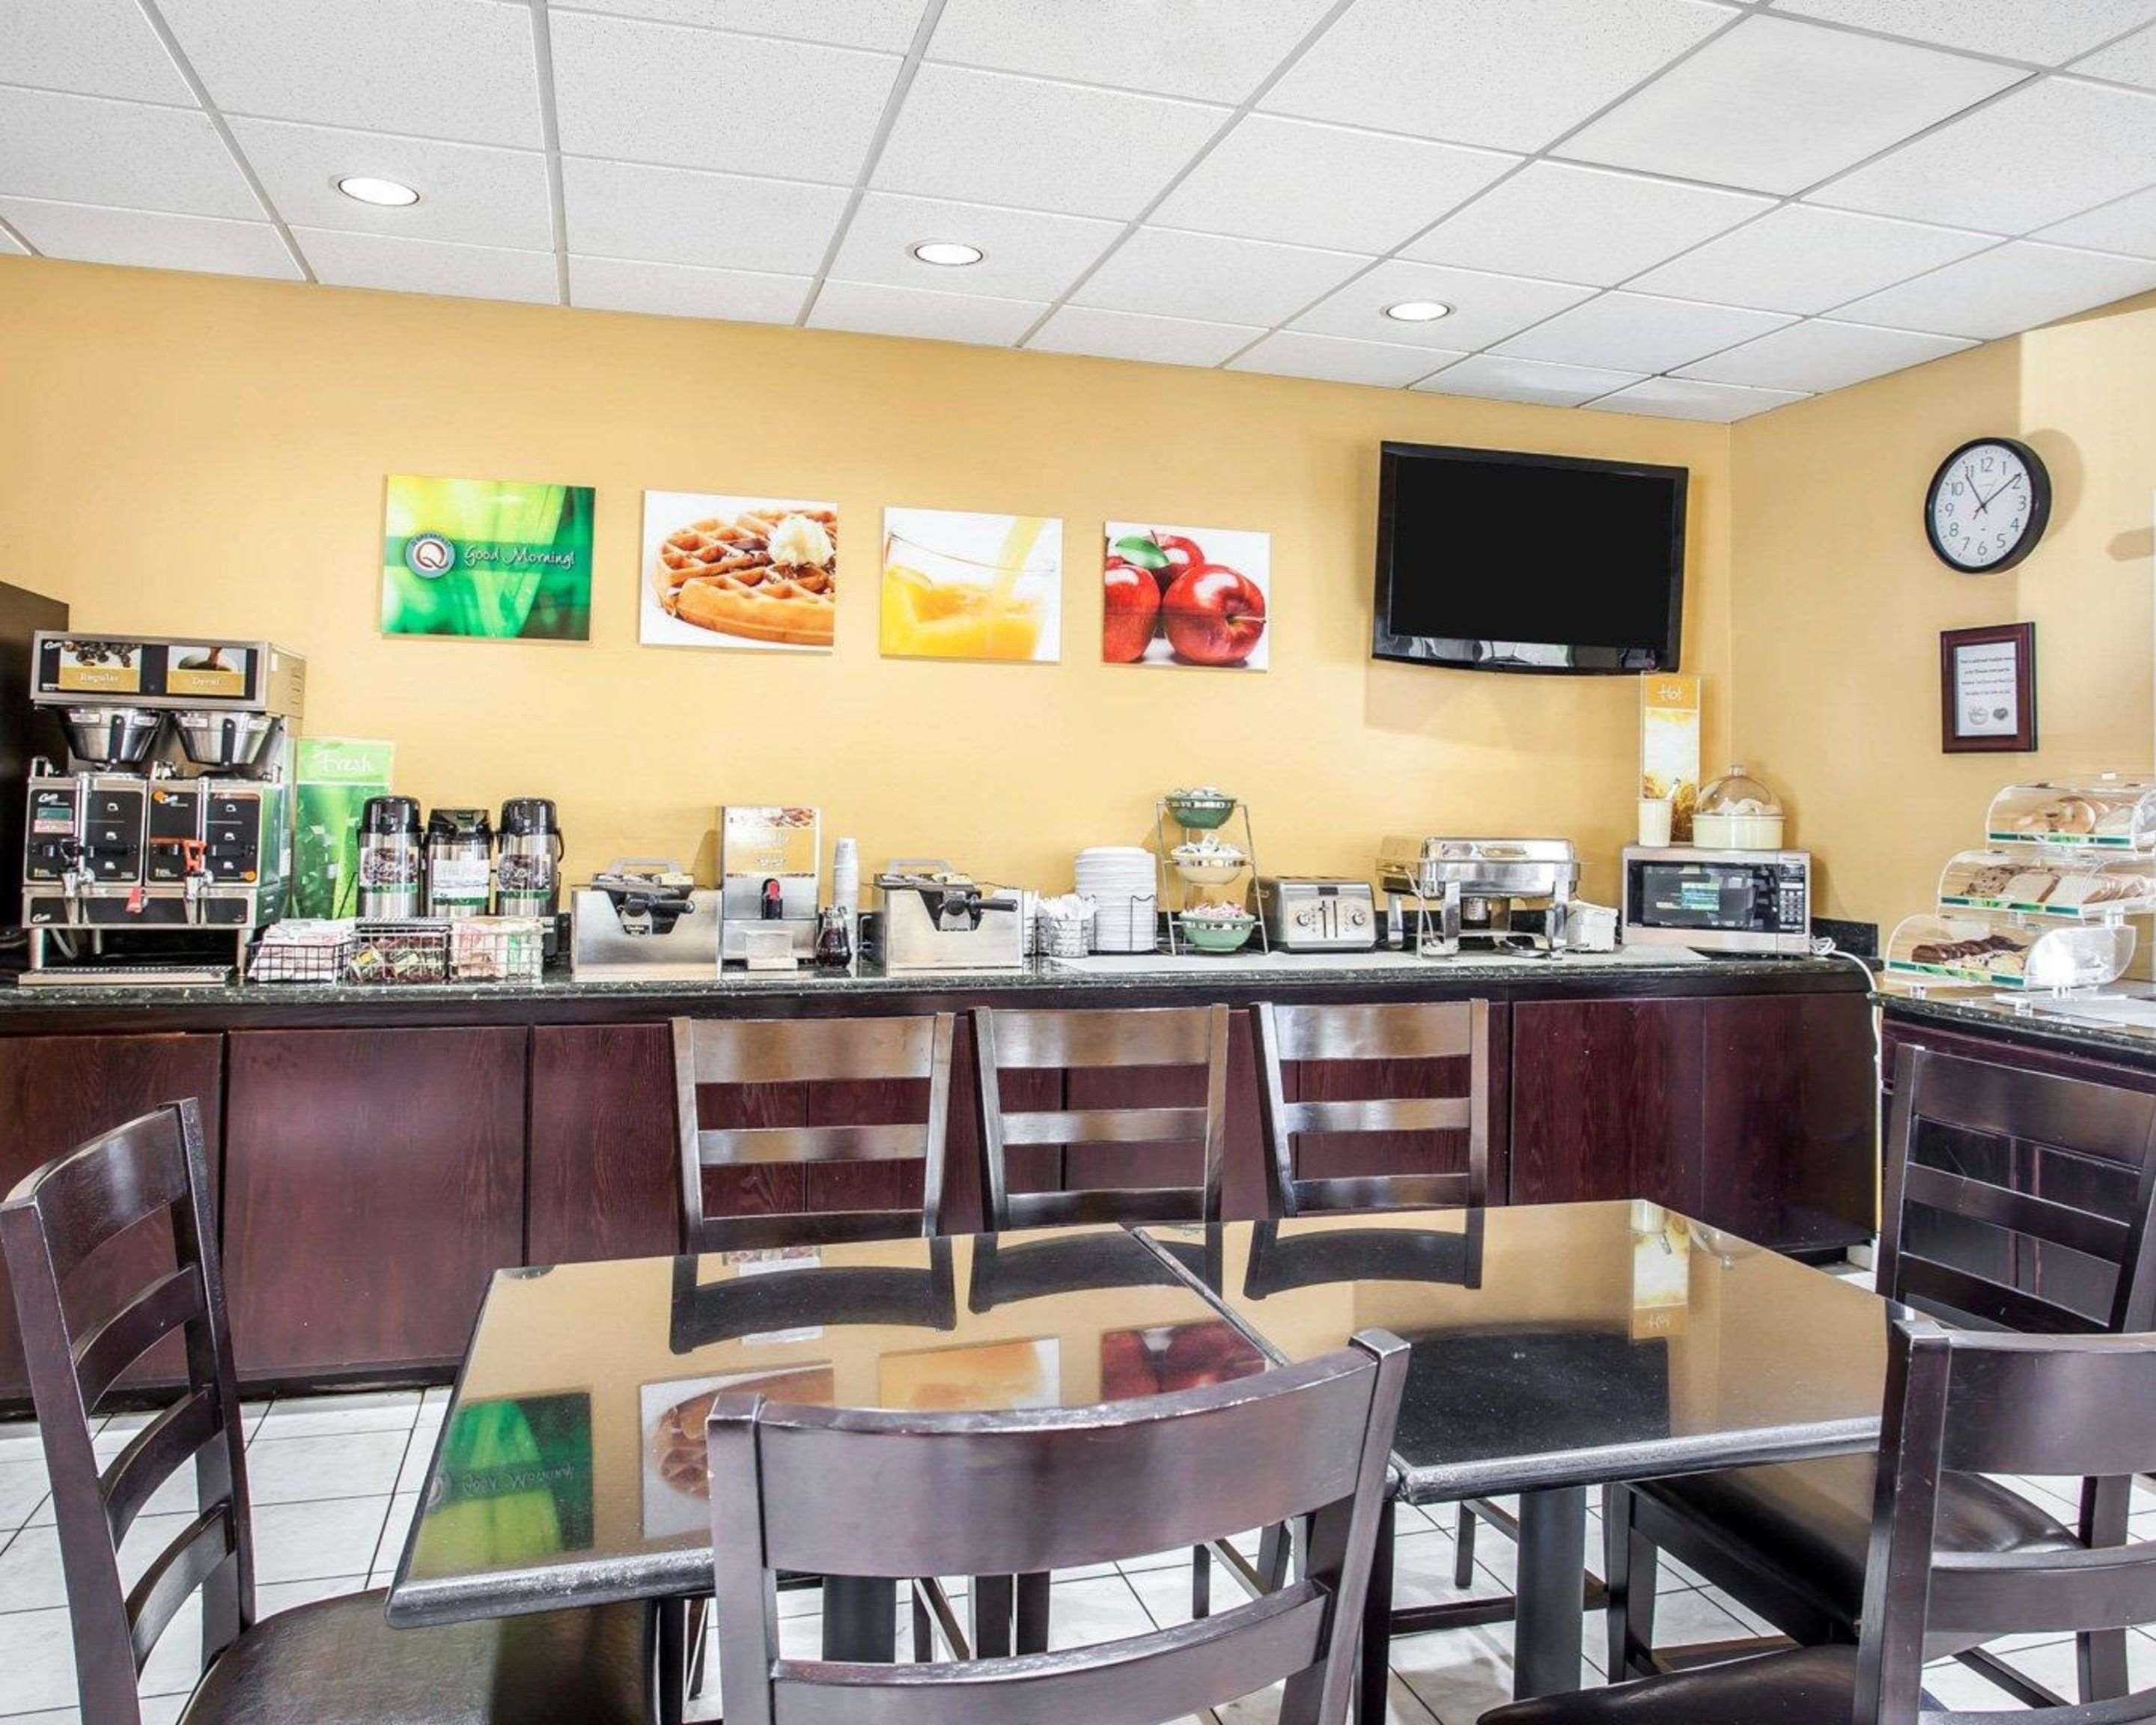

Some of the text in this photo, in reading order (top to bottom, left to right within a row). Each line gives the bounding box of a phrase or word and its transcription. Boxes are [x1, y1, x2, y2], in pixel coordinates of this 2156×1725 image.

[1965, 465, 1974, 479] 11
[1980, 457, 1994, 472] 12
[2002, 461, 2006, 475] 1
[1951, 481, 1964, 496] 10
[2012, 473, 2022, 489] 2
[1945, 503, 1955, 517] 9
[2018, 496, 2026, 511] 3
[1949, 523, 1959, 537] 8
[2010, 517, 2020, 532] 4
[1963, 537, 1970, 552] 7
[1997, 533, 2006, 548] 5
[1977, 541, 1988, 556] 6
[464, 544, 575, 570] Good Morning!
[1657, 683, 1683, 702] Hot
